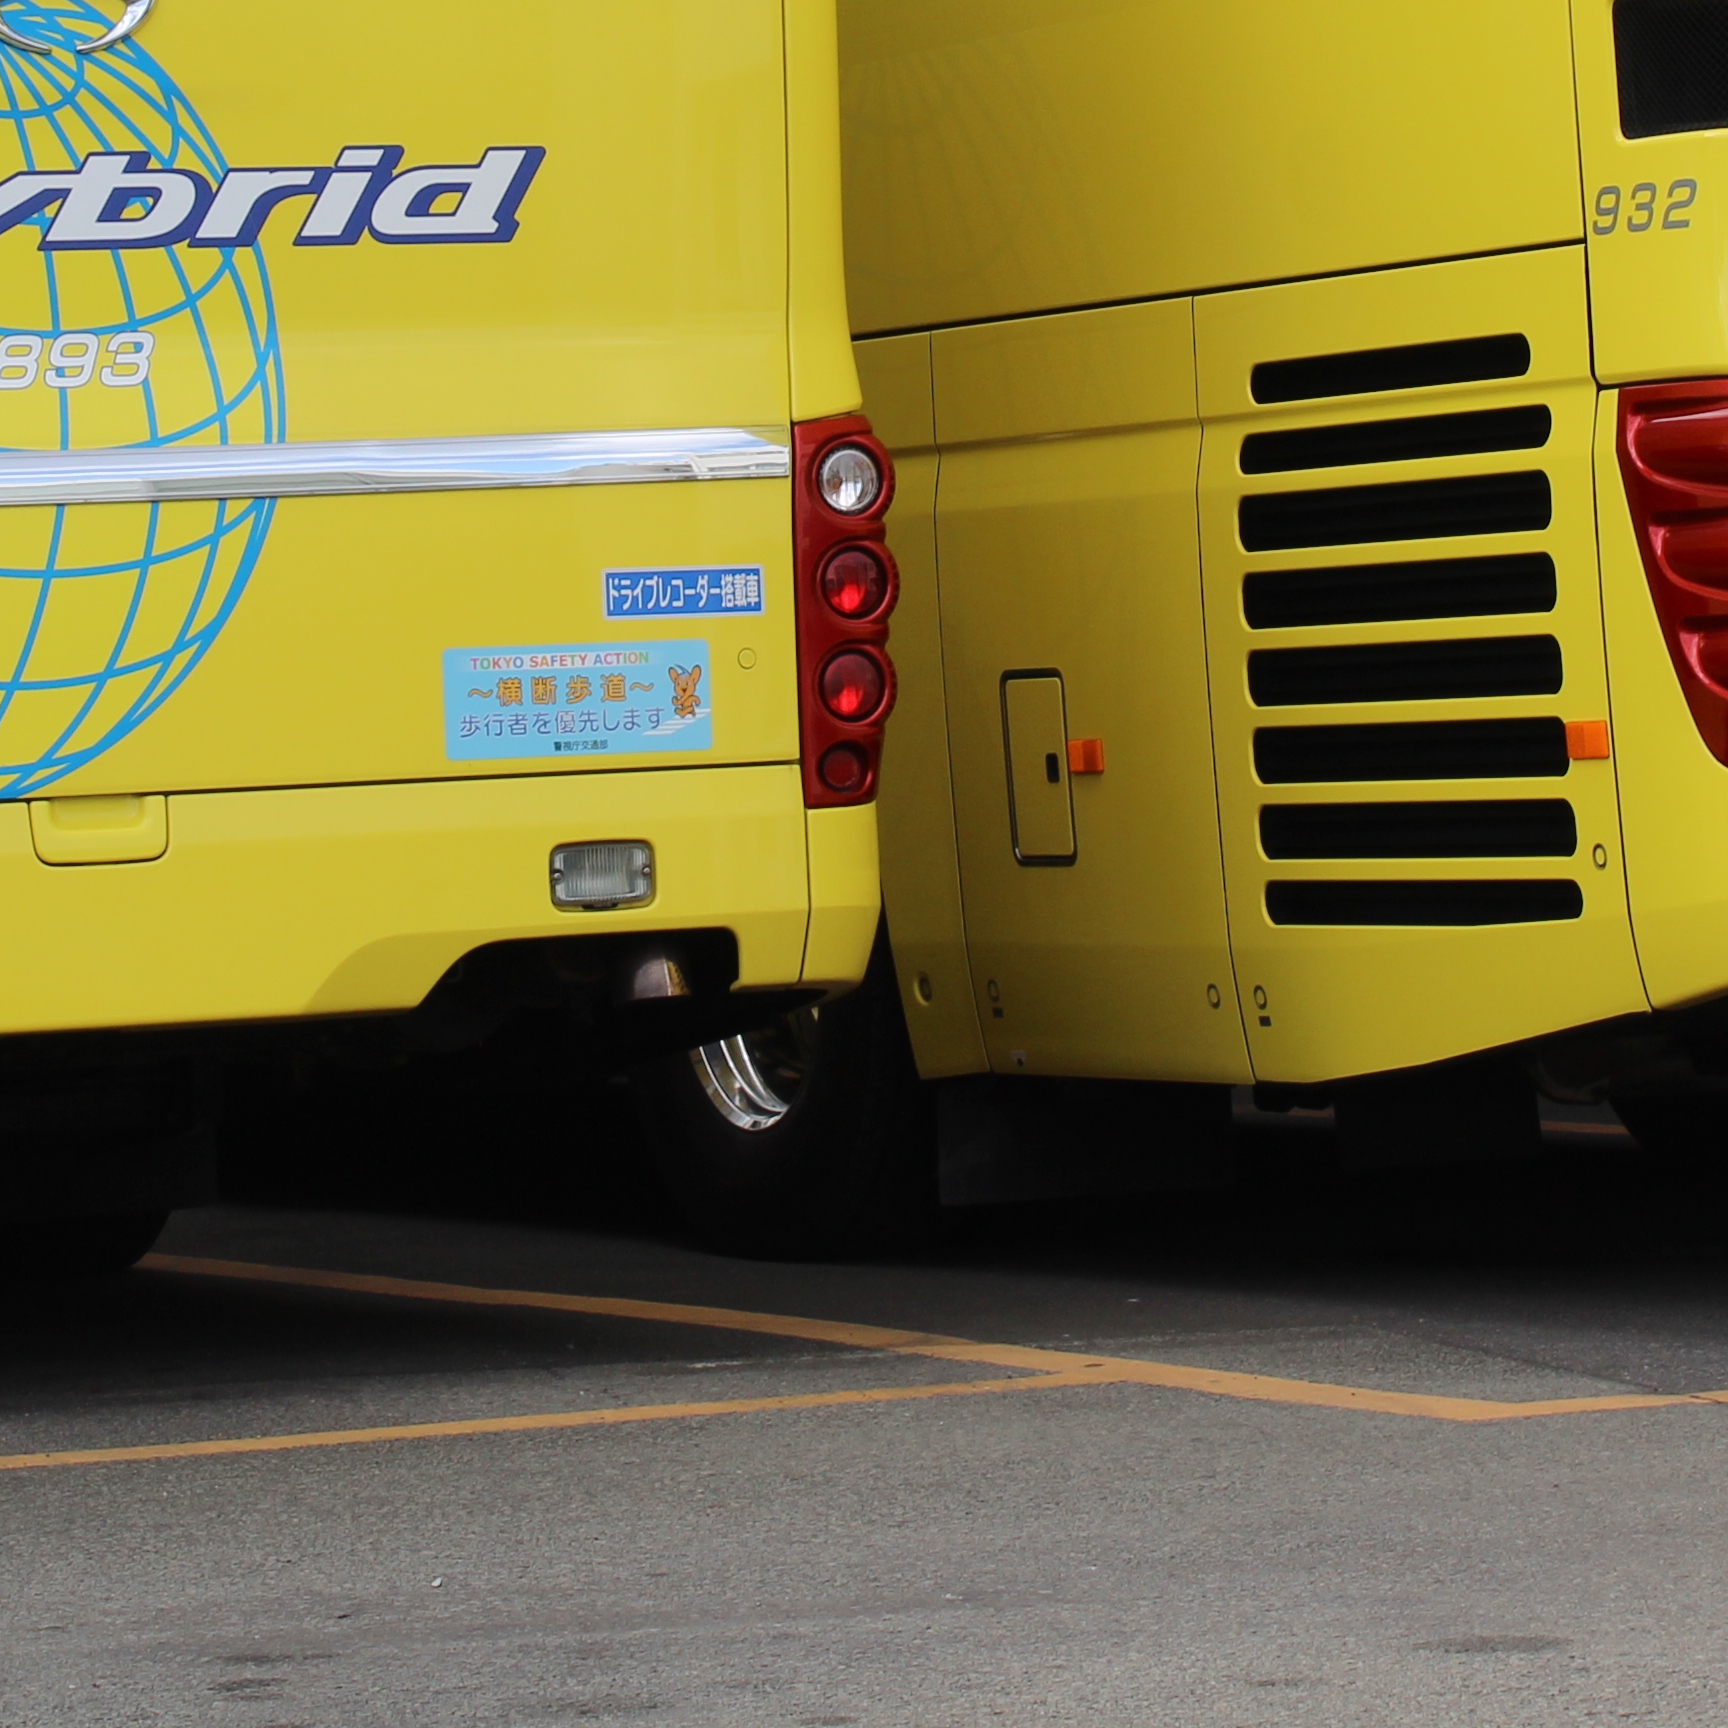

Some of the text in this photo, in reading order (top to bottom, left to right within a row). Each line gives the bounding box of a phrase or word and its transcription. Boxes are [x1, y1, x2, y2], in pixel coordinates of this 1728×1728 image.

[1592, 178, 1698, 235] 932
[607, 573, 760, 611] ドライブレコーダー搭載車
[470, 651, 649, 670] TOKYO SAFETY ACTION
[459, 706, 665, 738] 歩行者を優先します
